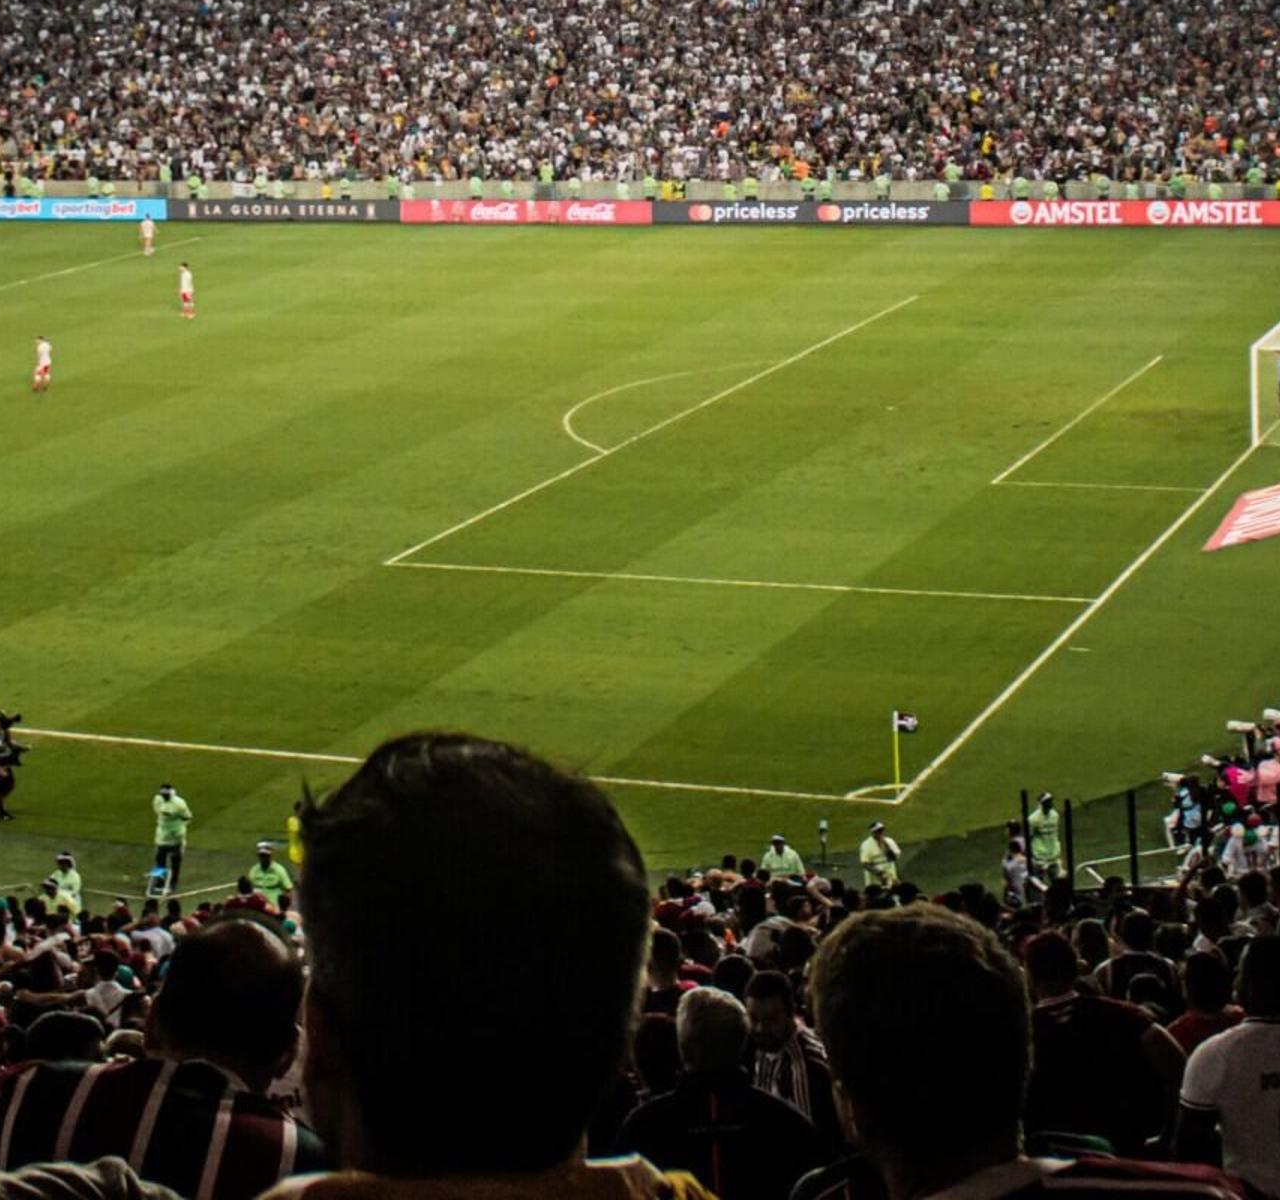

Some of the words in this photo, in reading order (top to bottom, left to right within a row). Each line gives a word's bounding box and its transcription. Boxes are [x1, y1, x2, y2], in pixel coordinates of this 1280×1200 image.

[53, 201, 135, 216] sportingbet
[204, 205, 222, 216] LA
[230, 205, 291, 216] GLORIA
[299, 205, 359, 216] ETERNA
[471, 202, 518, 221] Coca-Cola
[568, 202, 616, 221] Coca-Cola
[714, 203, 798, 222] priceless
[843, 203, 929, 222] priceless
[1034, 202, 1123, 224] AMSTEL
[1172, 202, 1262, 224] AMSTEL
